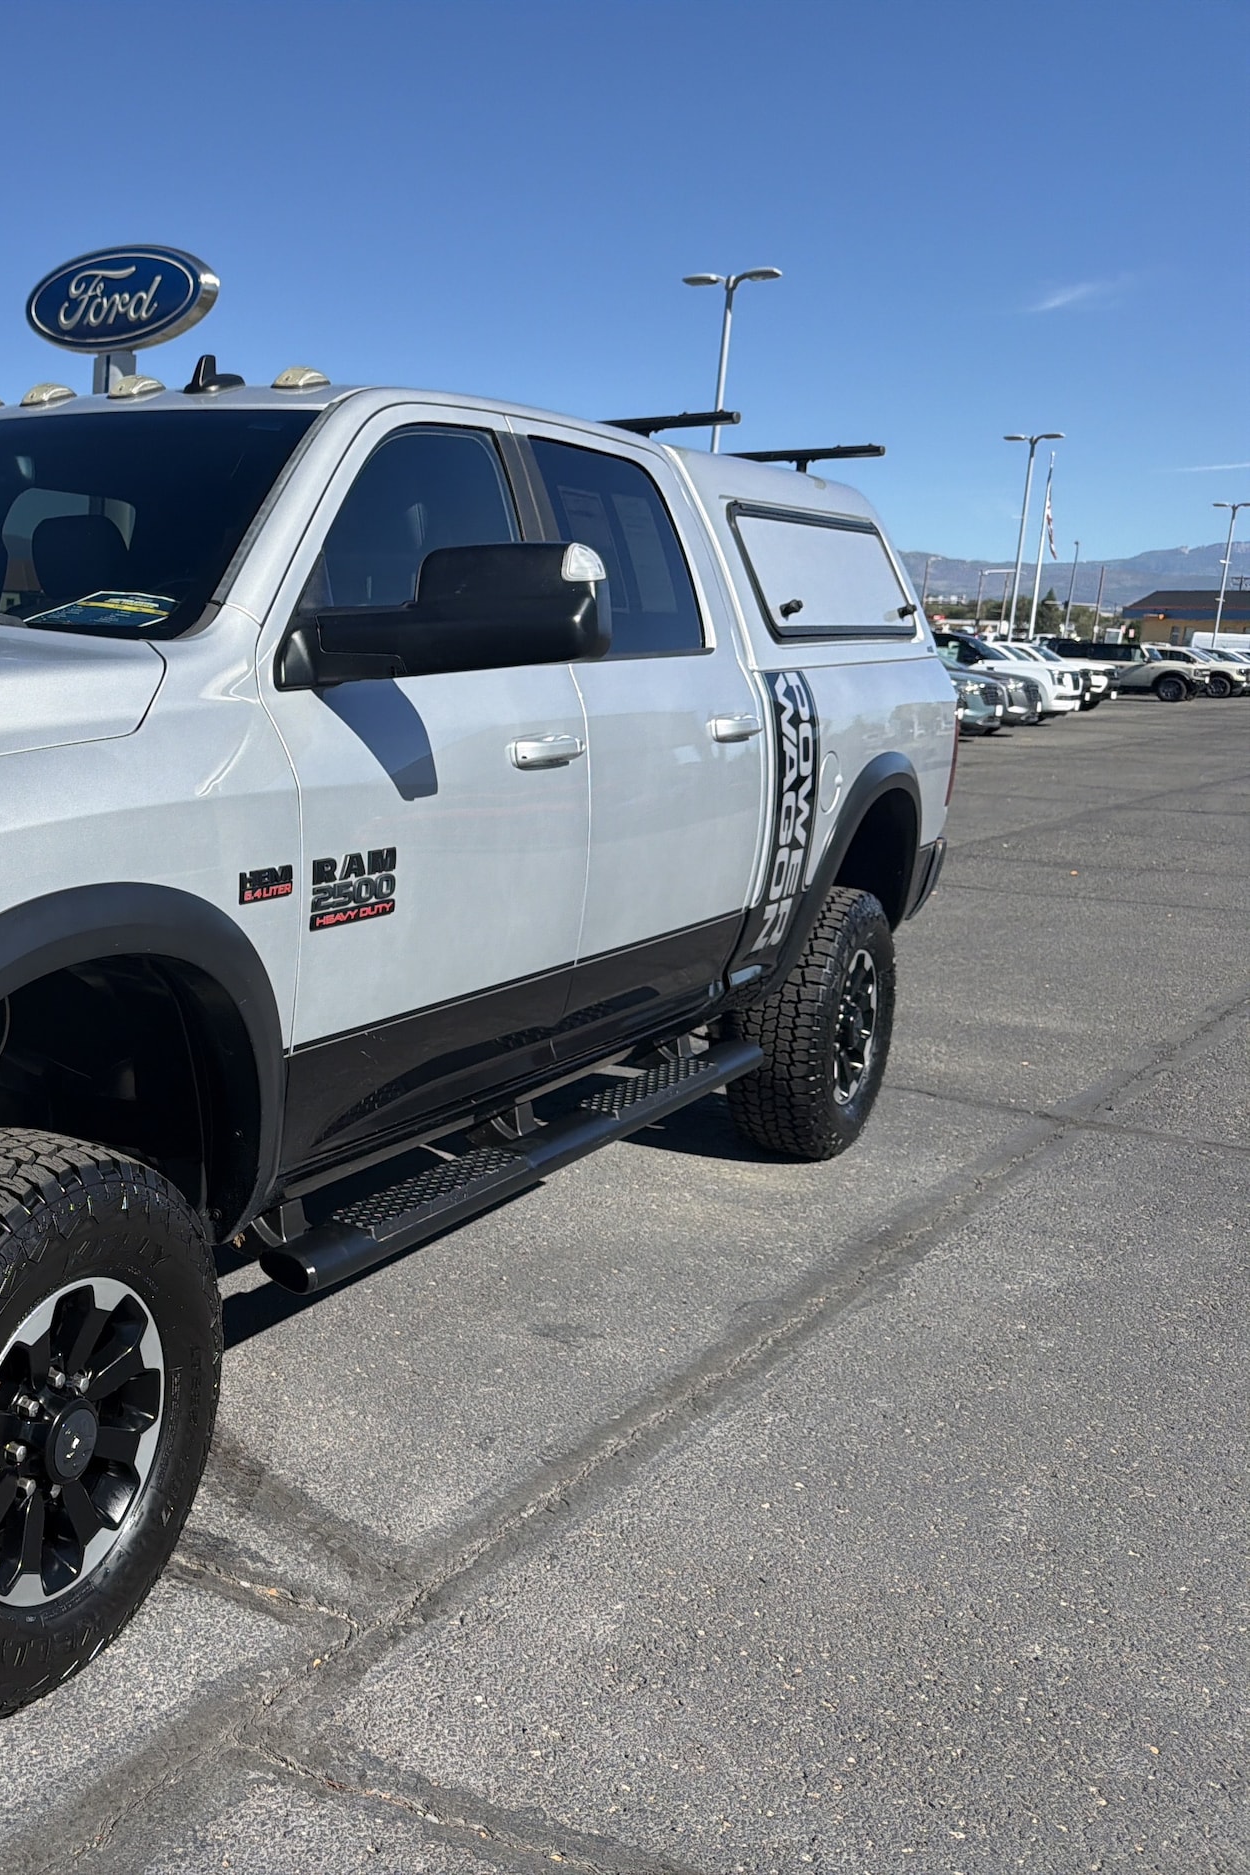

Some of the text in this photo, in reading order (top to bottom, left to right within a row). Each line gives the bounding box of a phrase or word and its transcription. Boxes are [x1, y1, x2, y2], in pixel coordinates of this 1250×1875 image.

[58, 265, 163, 331] Ford
[752, 673, 797, 953] WAGON
[769, 672, 813, 947] POWER
[239, 864, 293, 889] HEMI
[312, 846, 397, 885] RAM
[244, 883, 292, 902] 6.4 LITER
[311, 874, 396, 913] 2500
[316, 901, 394, 927] HEAVY DUTY
